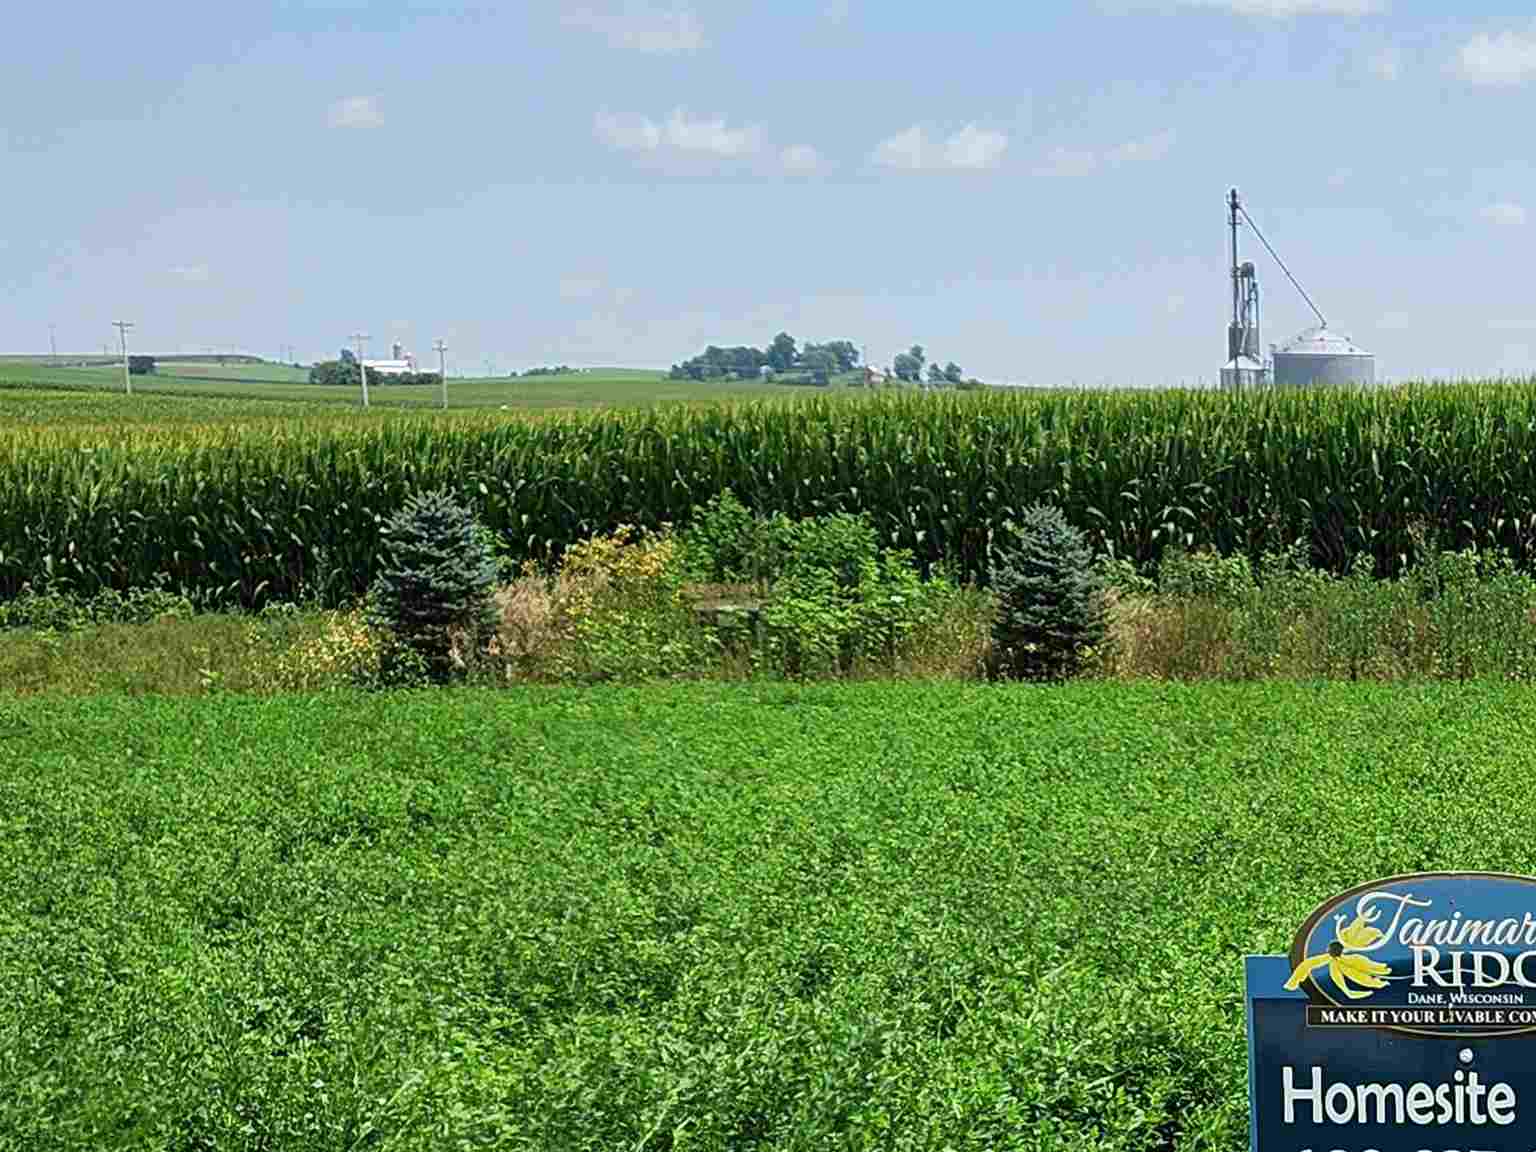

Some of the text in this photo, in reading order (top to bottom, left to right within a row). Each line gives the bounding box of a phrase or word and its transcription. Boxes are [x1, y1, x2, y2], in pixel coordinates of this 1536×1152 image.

[1320, 1010, 1368, 1024] MAKE
[1371, 1010, 1389, 1024] IT
[1390, 1010, 1435, 1024] YOUR
[1439, 1010, 1505, 1024] LIVABLE
[1282, 1065, 1517, 1125] Homesite
